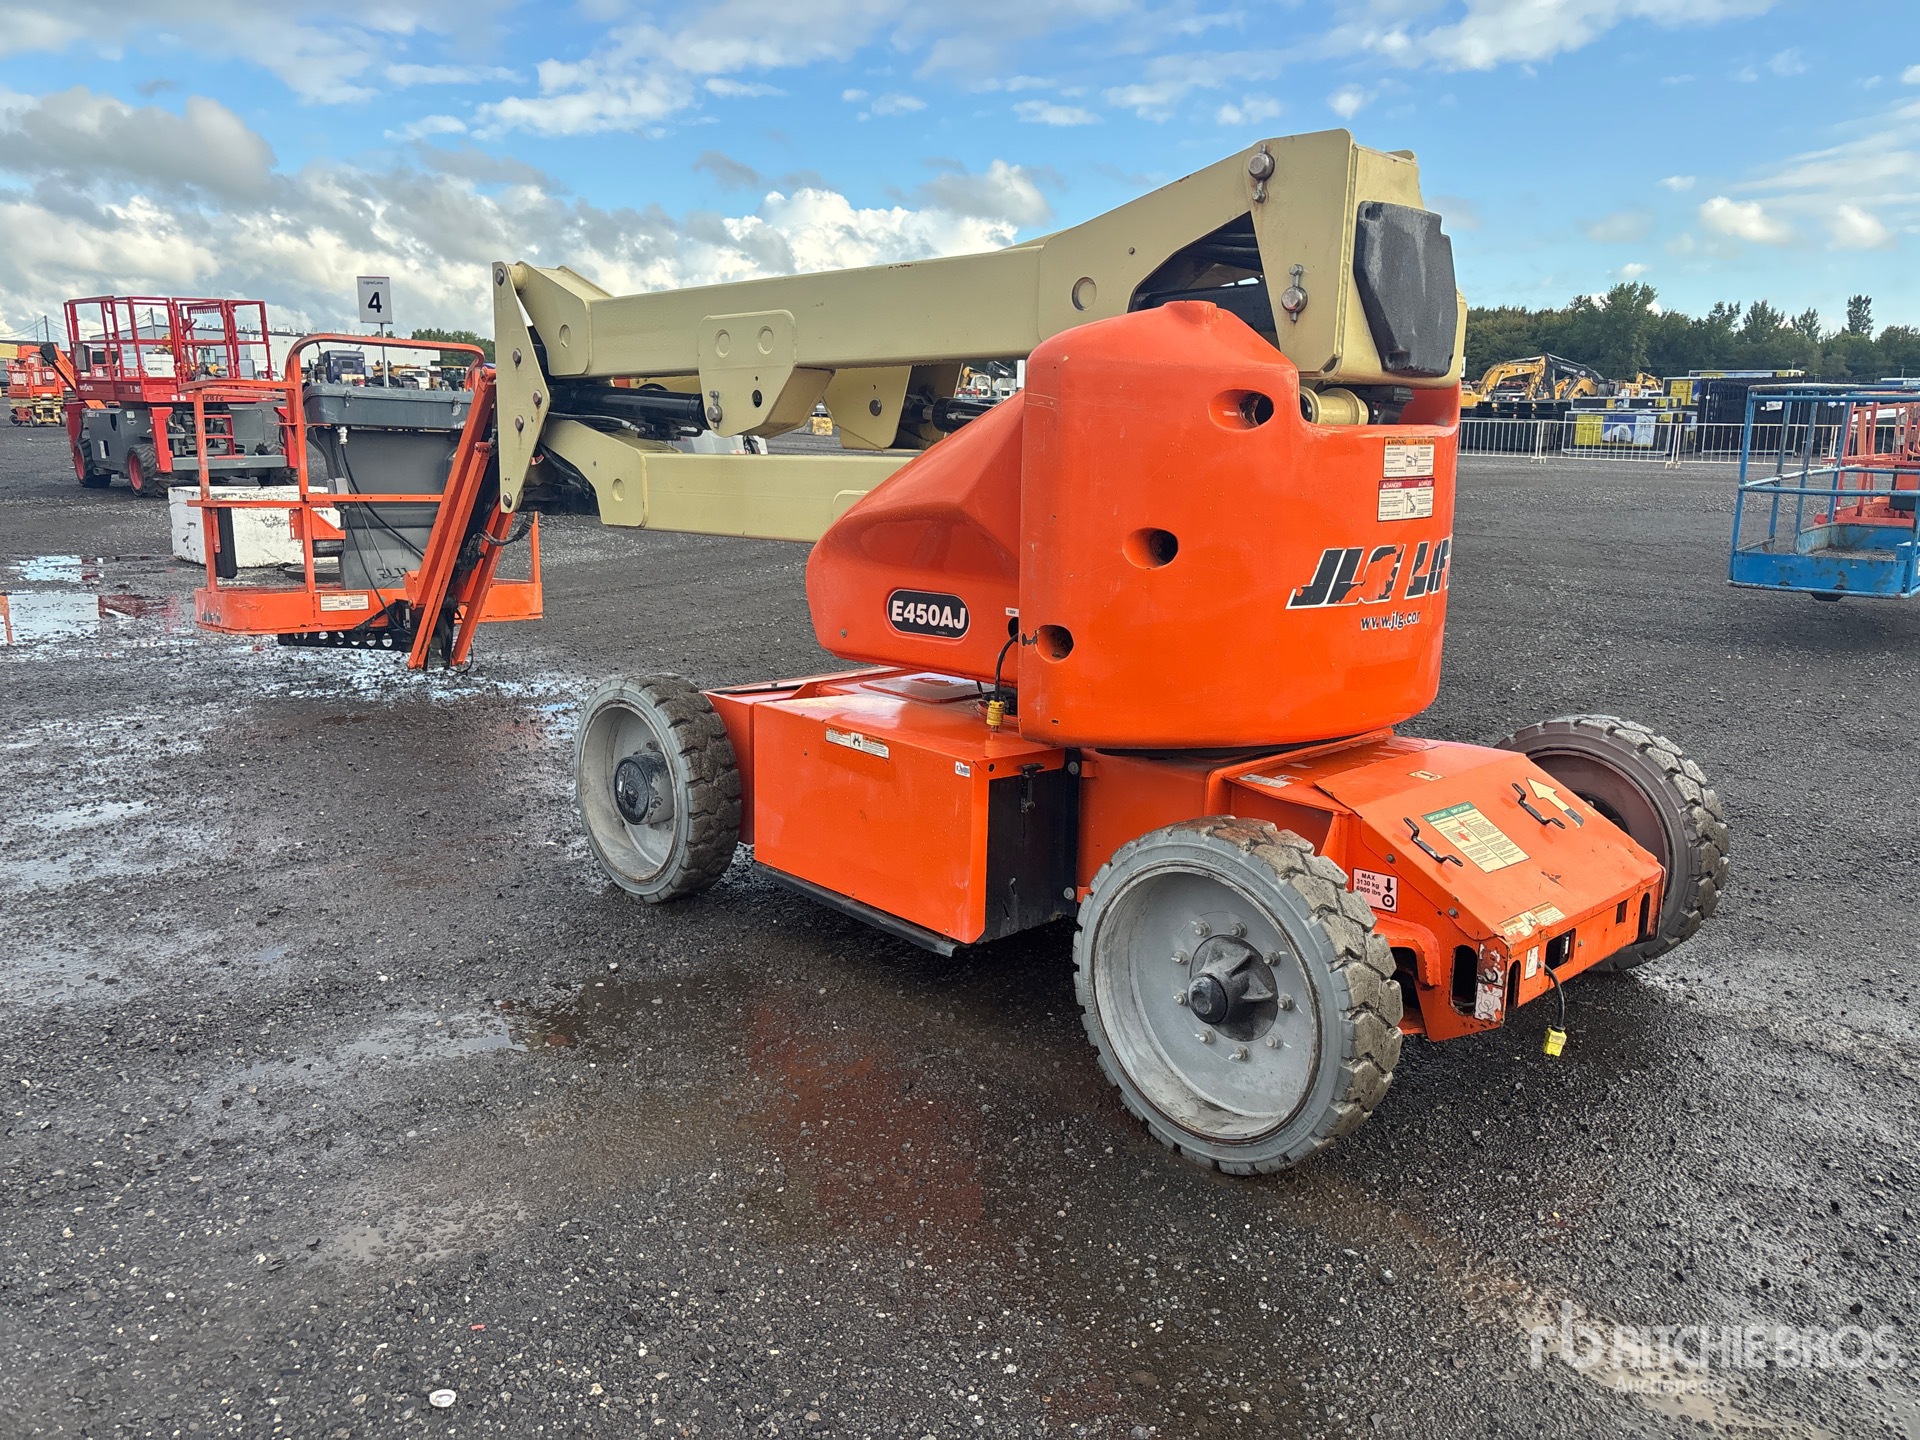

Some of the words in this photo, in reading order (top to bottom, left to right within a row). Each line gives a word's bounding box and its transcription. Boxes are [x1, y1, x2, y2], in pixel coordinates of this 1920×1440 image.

[367, 291, 382, 313] 4
[891, 600, 966, 629] E450AJ
[1361, 873, 1376, 881] MAX
